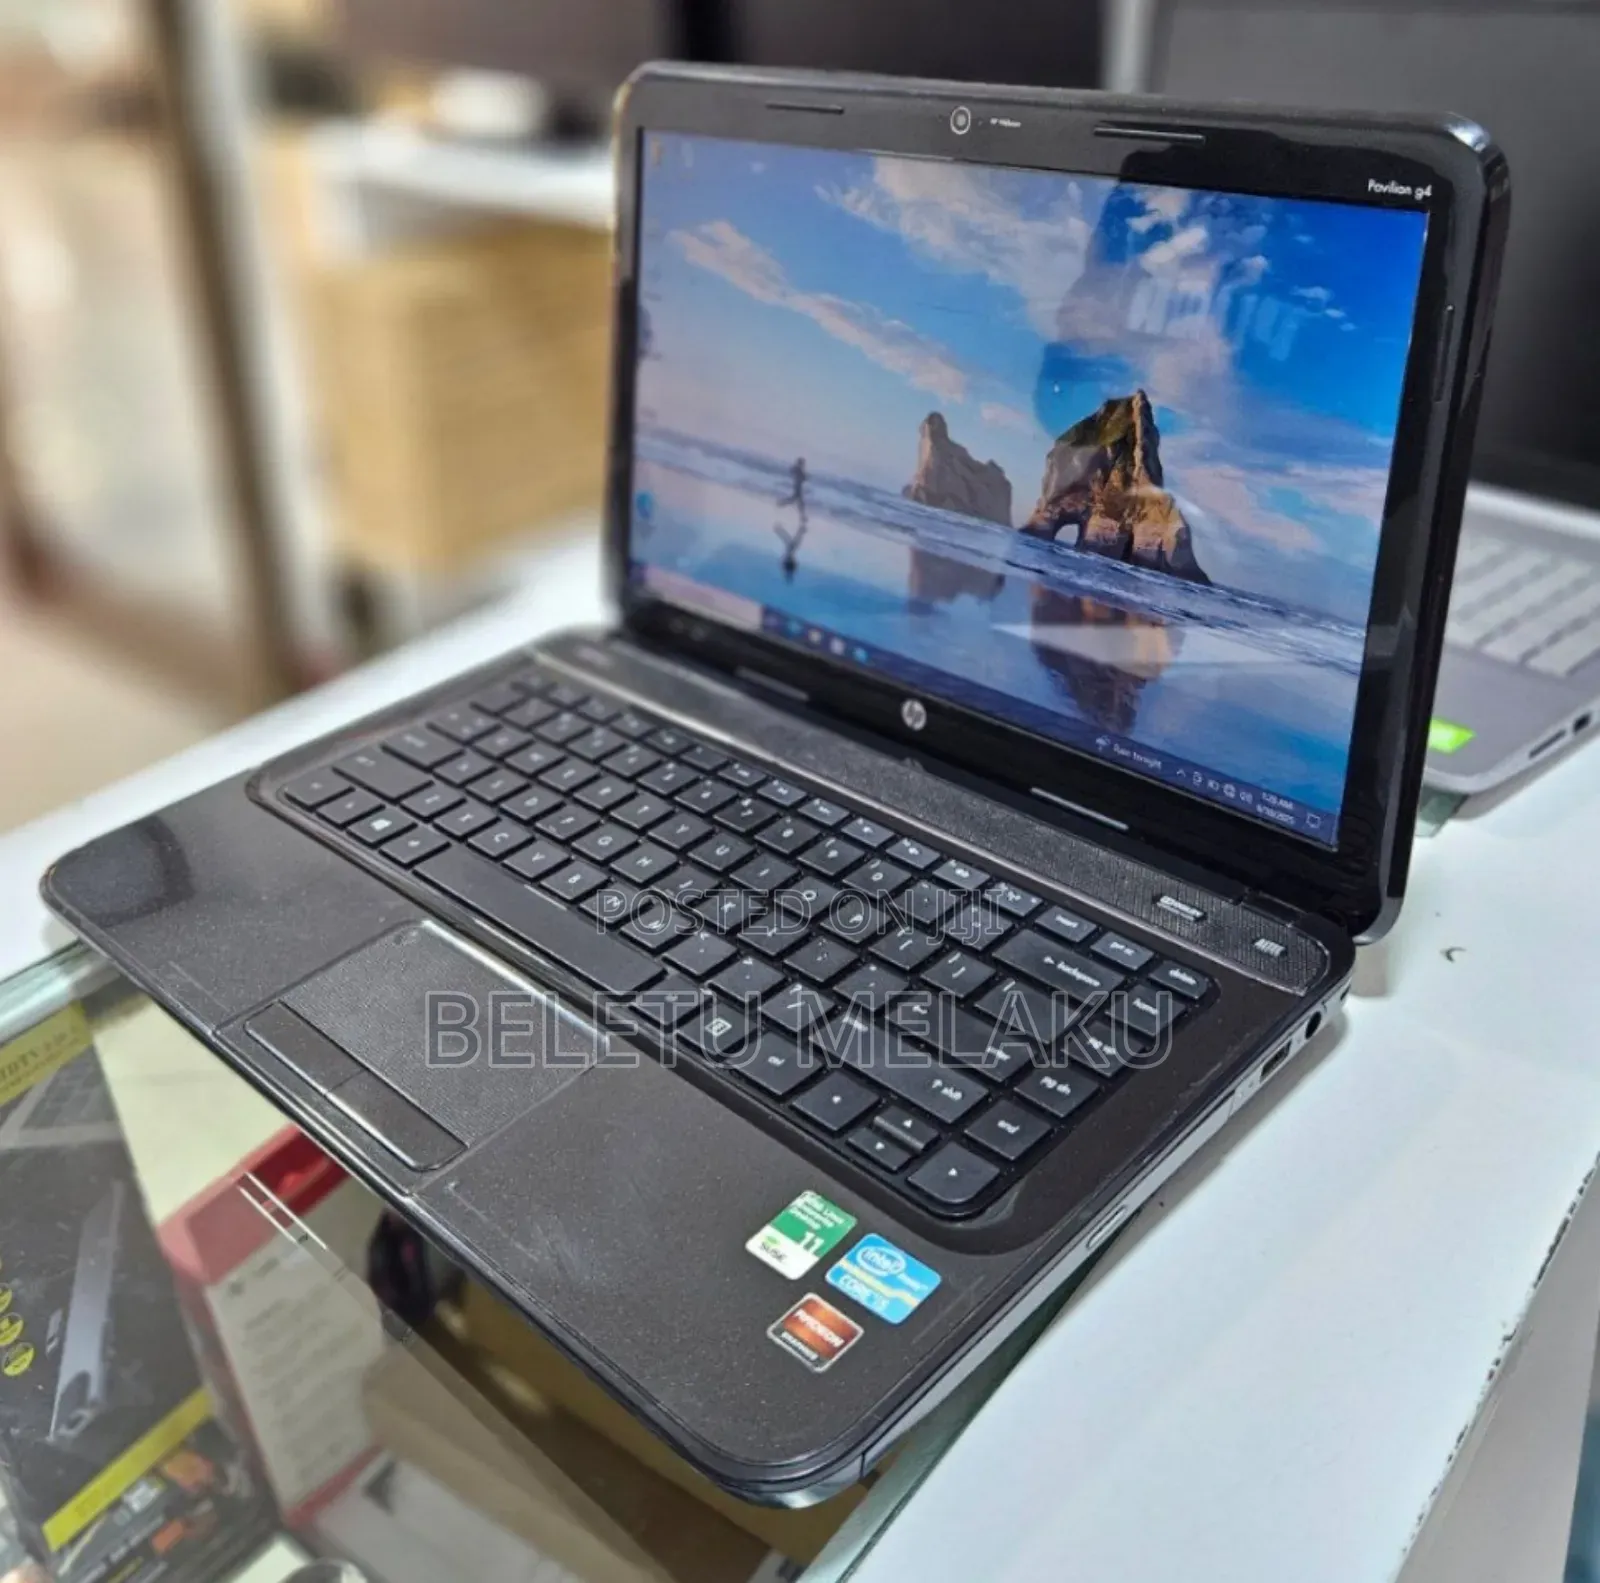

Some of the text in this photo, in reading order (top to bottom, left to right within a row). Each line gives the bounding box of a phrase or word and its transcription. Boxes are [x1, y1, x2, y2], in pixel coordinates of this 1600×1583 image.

[1368, 178, 1433, 200] Pavilion g4
[800, 1231, 825, 1254] 11
